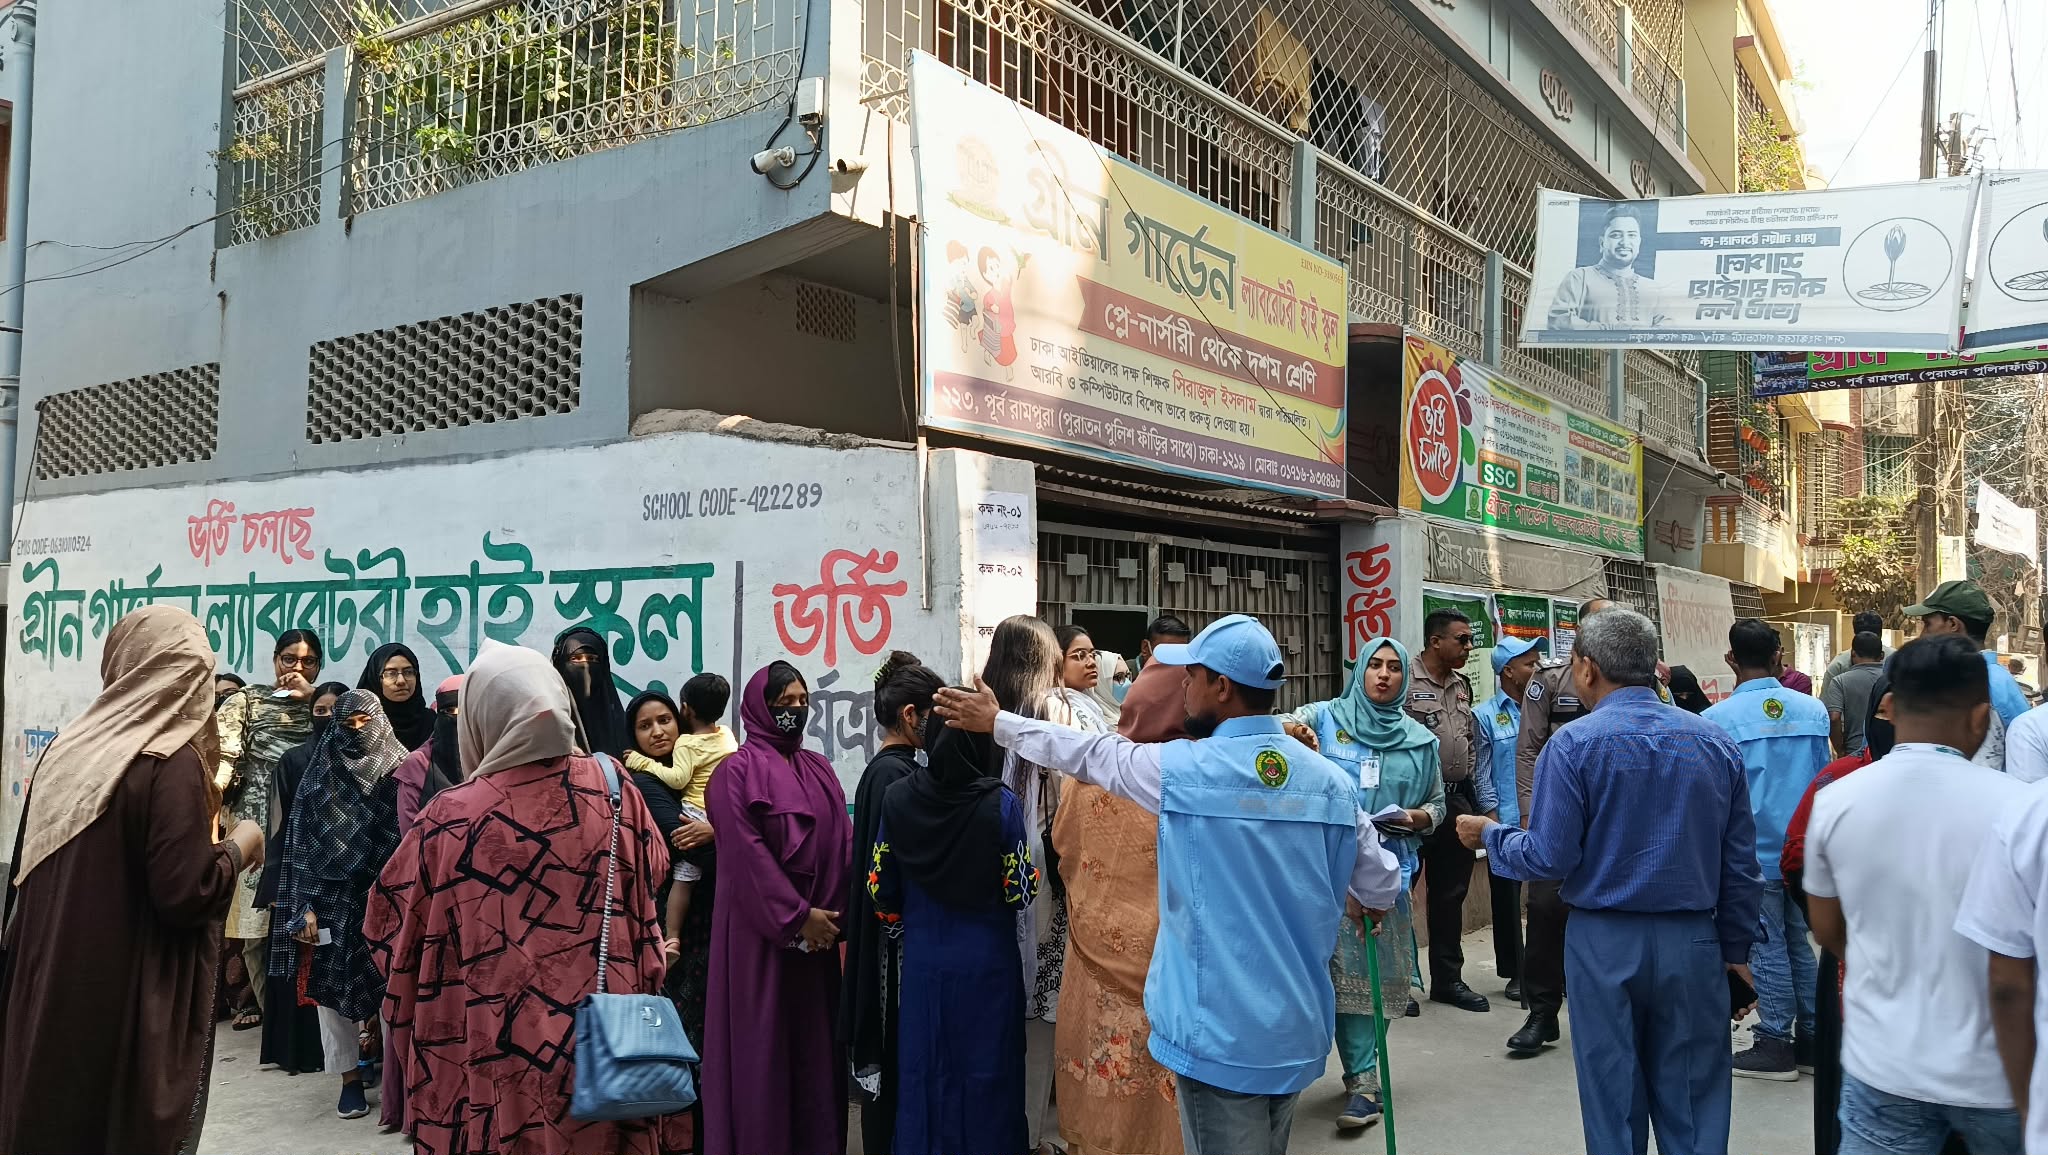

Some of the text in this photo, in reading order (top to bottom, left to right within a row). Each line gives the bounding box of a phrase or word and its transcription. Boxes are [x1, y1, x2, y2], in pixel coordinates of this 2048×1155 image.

[1123, 207, 1237, 313] গার্ডেন
[1104, 303, 1317, 396] প্লে-নার্সারী থেকে দশম শ্রেণি
[1299, 291, 1319, 344] হাই
[1320, 308, 1339, 360] স্কুল
[1030, 337, 1054, 358] ঢাকা
[1142, 367, 1170, 392] শিক্ষক
[1172, 369, 1217, 409] সিরাজুল
[1220, 383, 1257, 415] ইসলাম
[1031, 365, 1063, 388] আরবি
[1067, 375, 1076, 390] ও
[1136, 391, 1163, 415] বিশেষ
[1166, 402, 1186, 421] ভাবে
[1213, 415, 1237, 434] দেওয়া
[1810, 380, 1840, 390] ২২৩,
[1846, 374, 1865, 388] পূর্ব
[1867, 371, 1914, 386] রামপুরা,
[1919, 367, 1968, 383] (পুরাতন
[942, 385, 979, 415] ২২৩,
[984, 390, 1008, 422] পূর্ব
[1009, 399, 1055, 431] রামপুরা
[1058, 407, 1102, 440] (পুরাতন
[1104, 418, 1134, 446] পুলিশ
[1169, 438, 1197, 465] সাথে)
[1419, 394, 1449, 443] ভর্তি
[643, 482, 823, 521] SCHOOL CODE-422289
[997, 504, 1022, 518] নং-০১
[1483, 465, 1516, 489] SSC
[1484, 487, 1512, 523] গ্রীন
[1515, 502, 1550, 530] গার্ডেন
[187, 499, 315, 567] ভর্তি চলছে
[20, 557, 86, 672] গ্রীন
[414, 530, 545, 675] হাই
[549, 562, 715, 698] স্কুল
[771, 547, 908, 667] ভর্তি
